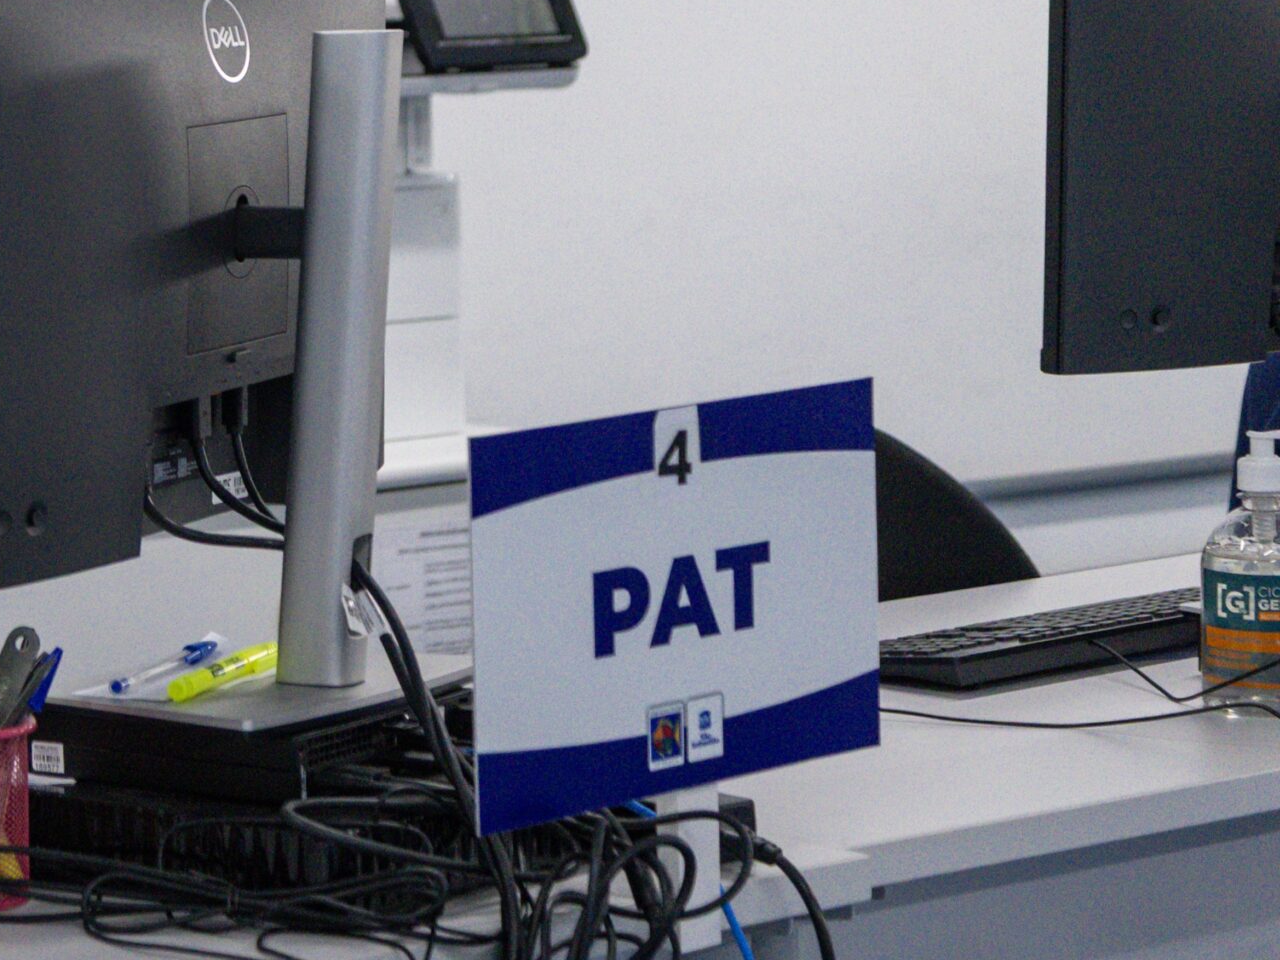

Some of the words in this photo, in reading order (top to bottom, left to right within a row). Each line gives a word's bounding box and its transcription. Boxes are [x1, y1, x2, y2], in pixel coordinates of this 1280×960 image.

[209, 26, 245, 49] DELL
[657, 429, 692, 486] 4
[592, 540, 771, 659] PAT
